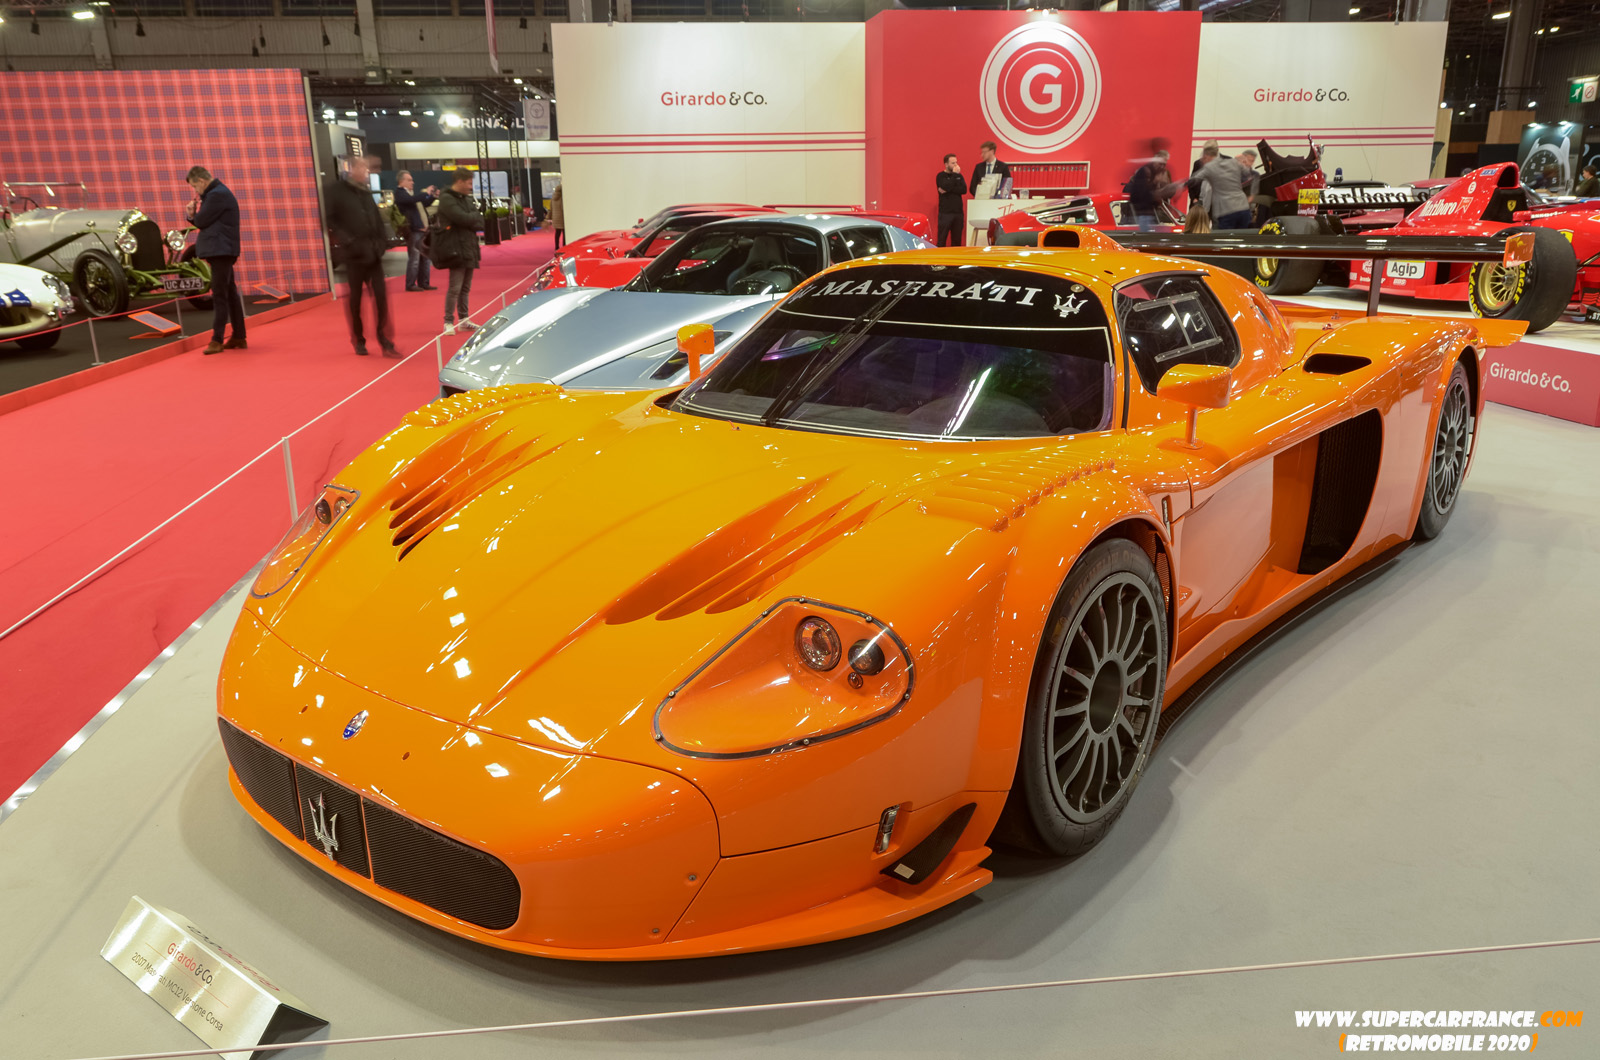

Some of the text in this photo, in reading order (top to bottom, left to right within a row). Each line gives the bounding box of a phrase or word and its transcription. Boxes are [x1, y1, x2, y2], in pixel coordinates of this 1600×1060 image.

[660, 91, 727, 106] Girardo
[1020, 63, 1062, 114] G
[1254, 88, 1313, 102] Girardo
[1391, 261, 1418, 277] Agip
[811, 279, 1043, 306] MASERATI
[1489, 361, 1539, 386] Girardo
[167, 942, 197, 972] Girardo
[165, 979, 184, 998] MC12
[182, 991, 207, 1017] Versione
[205, 1011, 224, 1032] Corsa
